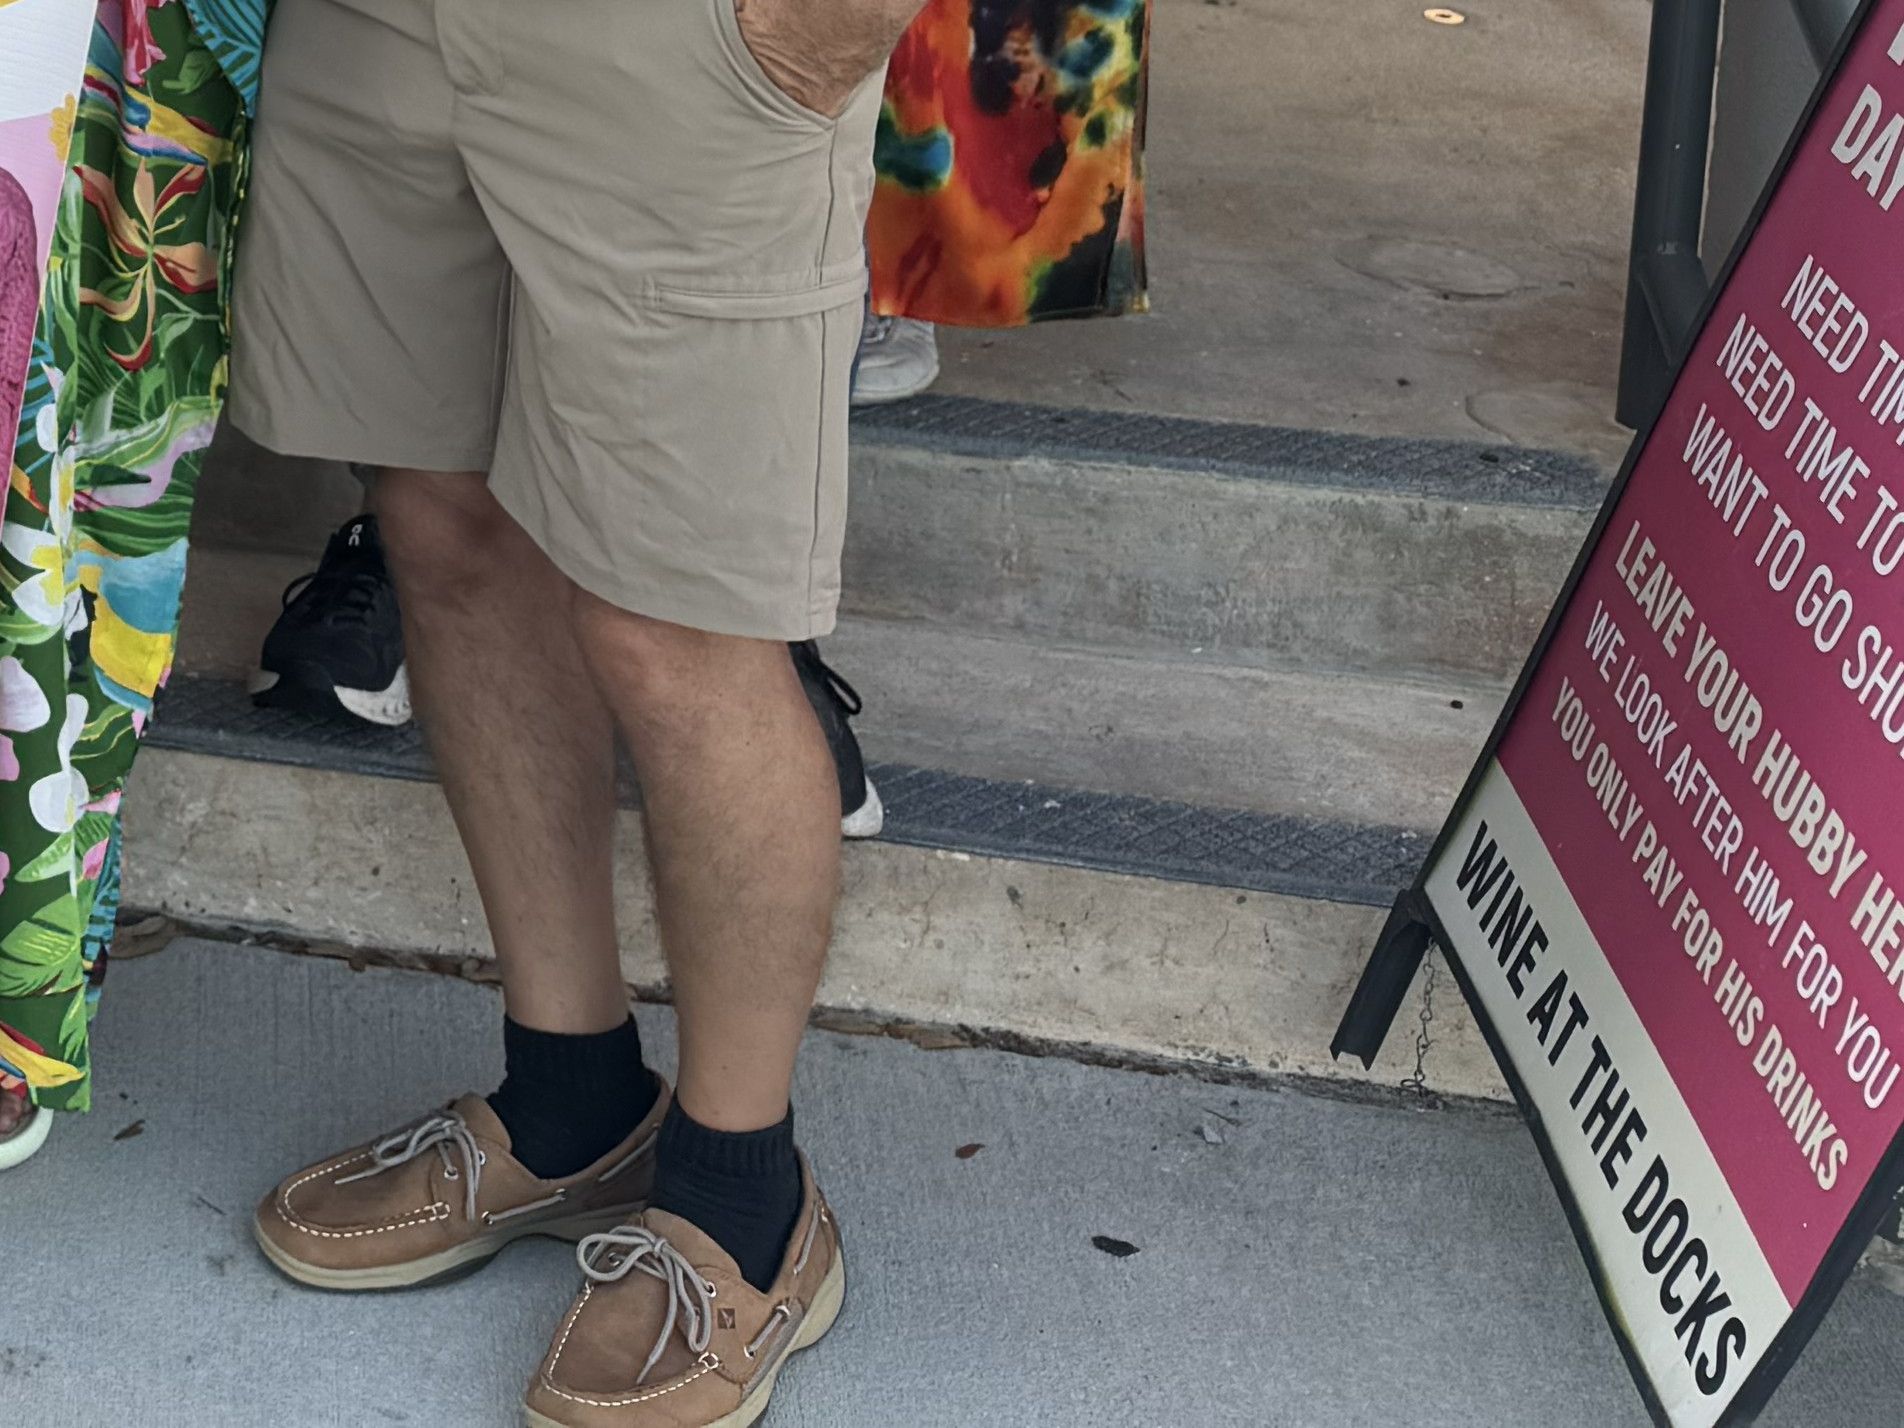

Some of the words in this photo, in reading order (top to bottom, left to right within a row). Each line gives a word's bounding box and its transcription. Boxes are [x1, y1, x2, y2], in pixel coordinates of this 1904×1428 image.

[1715, 313, 1796, 431] NEED
[1784, 397, 1871, 525] TIME
[1781, 254, 1869, 373] NEED
[1614, 519, 1695, 659] LEAVE
[1683, 621, 1763, 765] YOUR
[1752, 728, 1868, 899] HUBBY
[1682, 402, 1769, 537] WANT
[1754, 503, 1806, 592] TO
[1795, 564, 1853, 653] GO
[1551, 676, 1597, 762] YOU
[1586, 742, 1644, 842] ONLY
[1631, 820, 1684, 908] PAY
[1671, 887, 1724, 985] FOR
[1713, 958, 1765, 1046] HIS
[1752, 1023, 1848, 1191] DRINKS
[1584, 600, 1626, 683] WE
[1614, 654, 1678, 769] LOOK
[1664, 743, 1743, 875] AFTER
[1733, 845, 1794, 947] HIM
[1781, 919, 1843, 1029] FOR
[1835, 996, 1901, 1109] YOU
[1455, 819, 1549, 1000] WINE
[1525, 969, 1589, 1067] AT
[1569, 1035, 1649, 1191] THE
[1621, 1154, 1747, 1397] DOCKS
